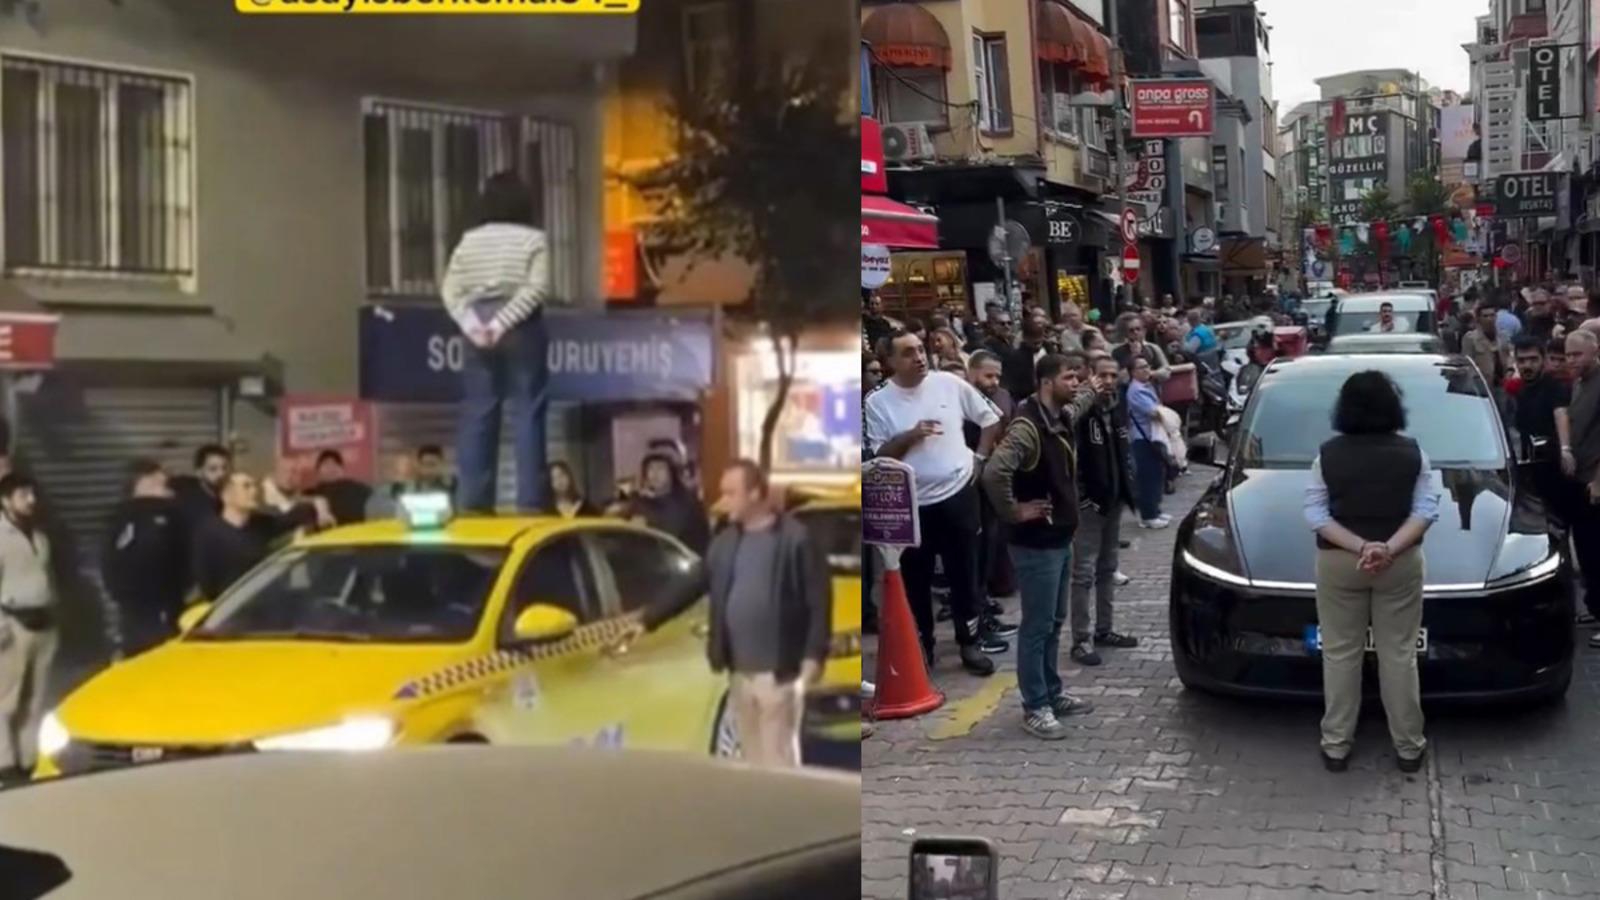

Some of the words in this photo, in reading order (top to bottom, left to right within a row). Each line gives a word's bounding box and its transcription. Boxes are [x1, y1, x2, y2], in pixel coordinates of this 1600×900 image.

[1137, 88, 1171, 103] anpa
[1174, 87, 1209, 104] gross
[1534, 49, 1554, 118] OTEL
[1503, 176, 1554, 198] OTEL
[547, 335, 673, 378] URUYEMİŞ
